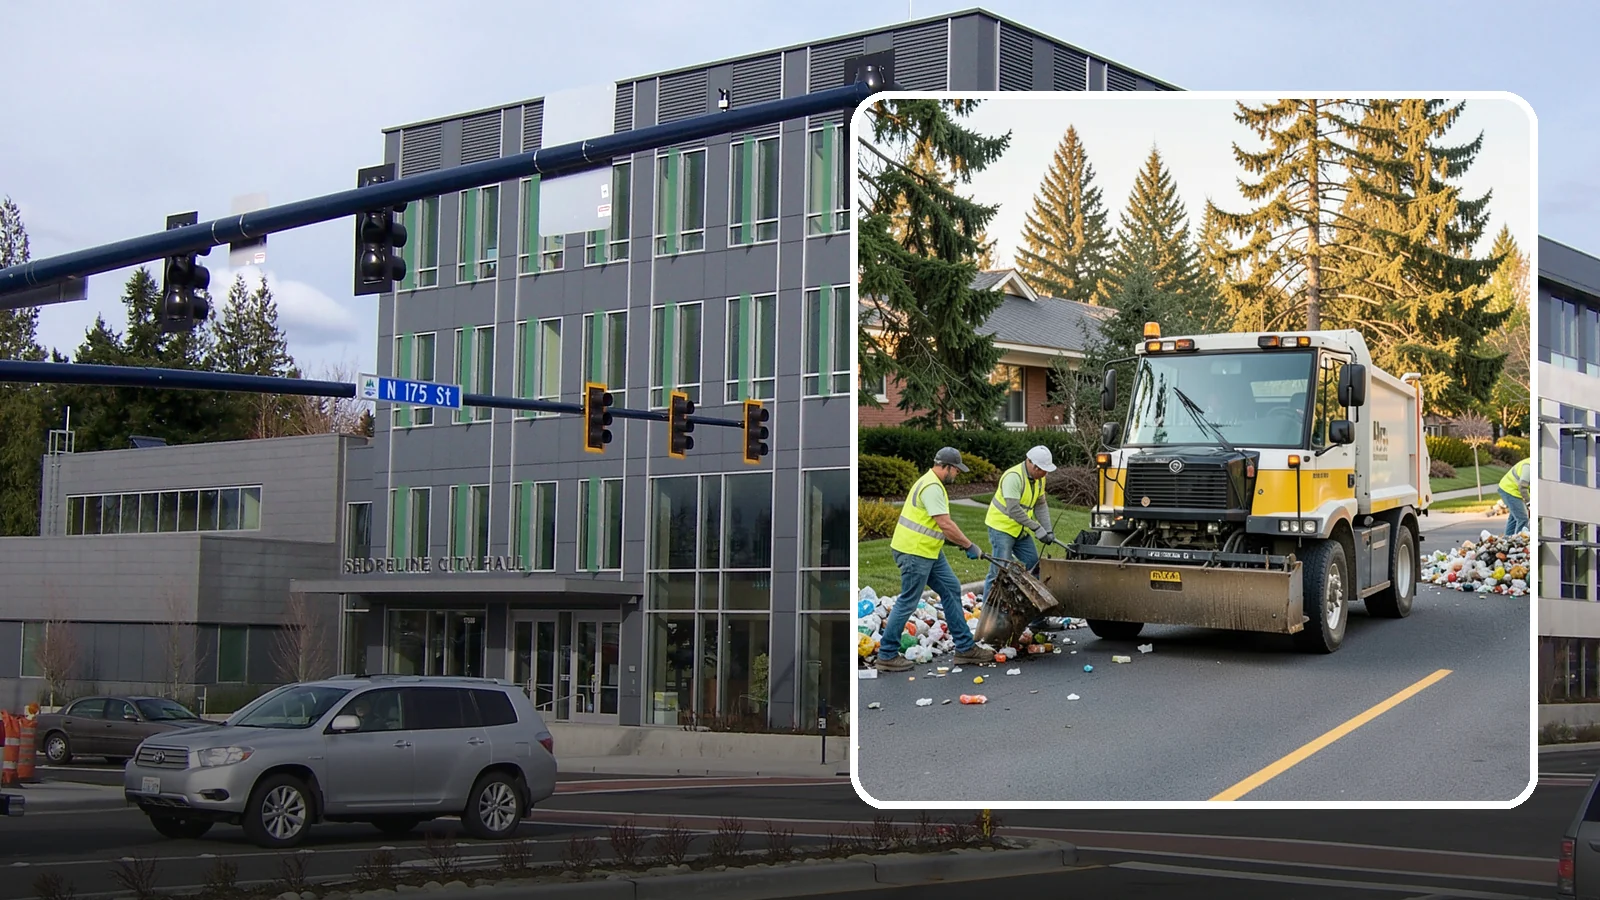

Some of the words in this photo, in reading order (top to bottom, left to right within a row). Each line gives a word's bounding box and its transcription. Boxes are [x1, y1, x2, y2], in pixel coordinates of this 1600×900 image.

[387, 380, 396, 400] N
[405, 382, 427, 403] 175
[436, 386, 451, 406] St
[343, 557, 430, 574] SHORELINE
[438, 556, 475, 572] CITY
[484, 555, 525, 571] HALL
